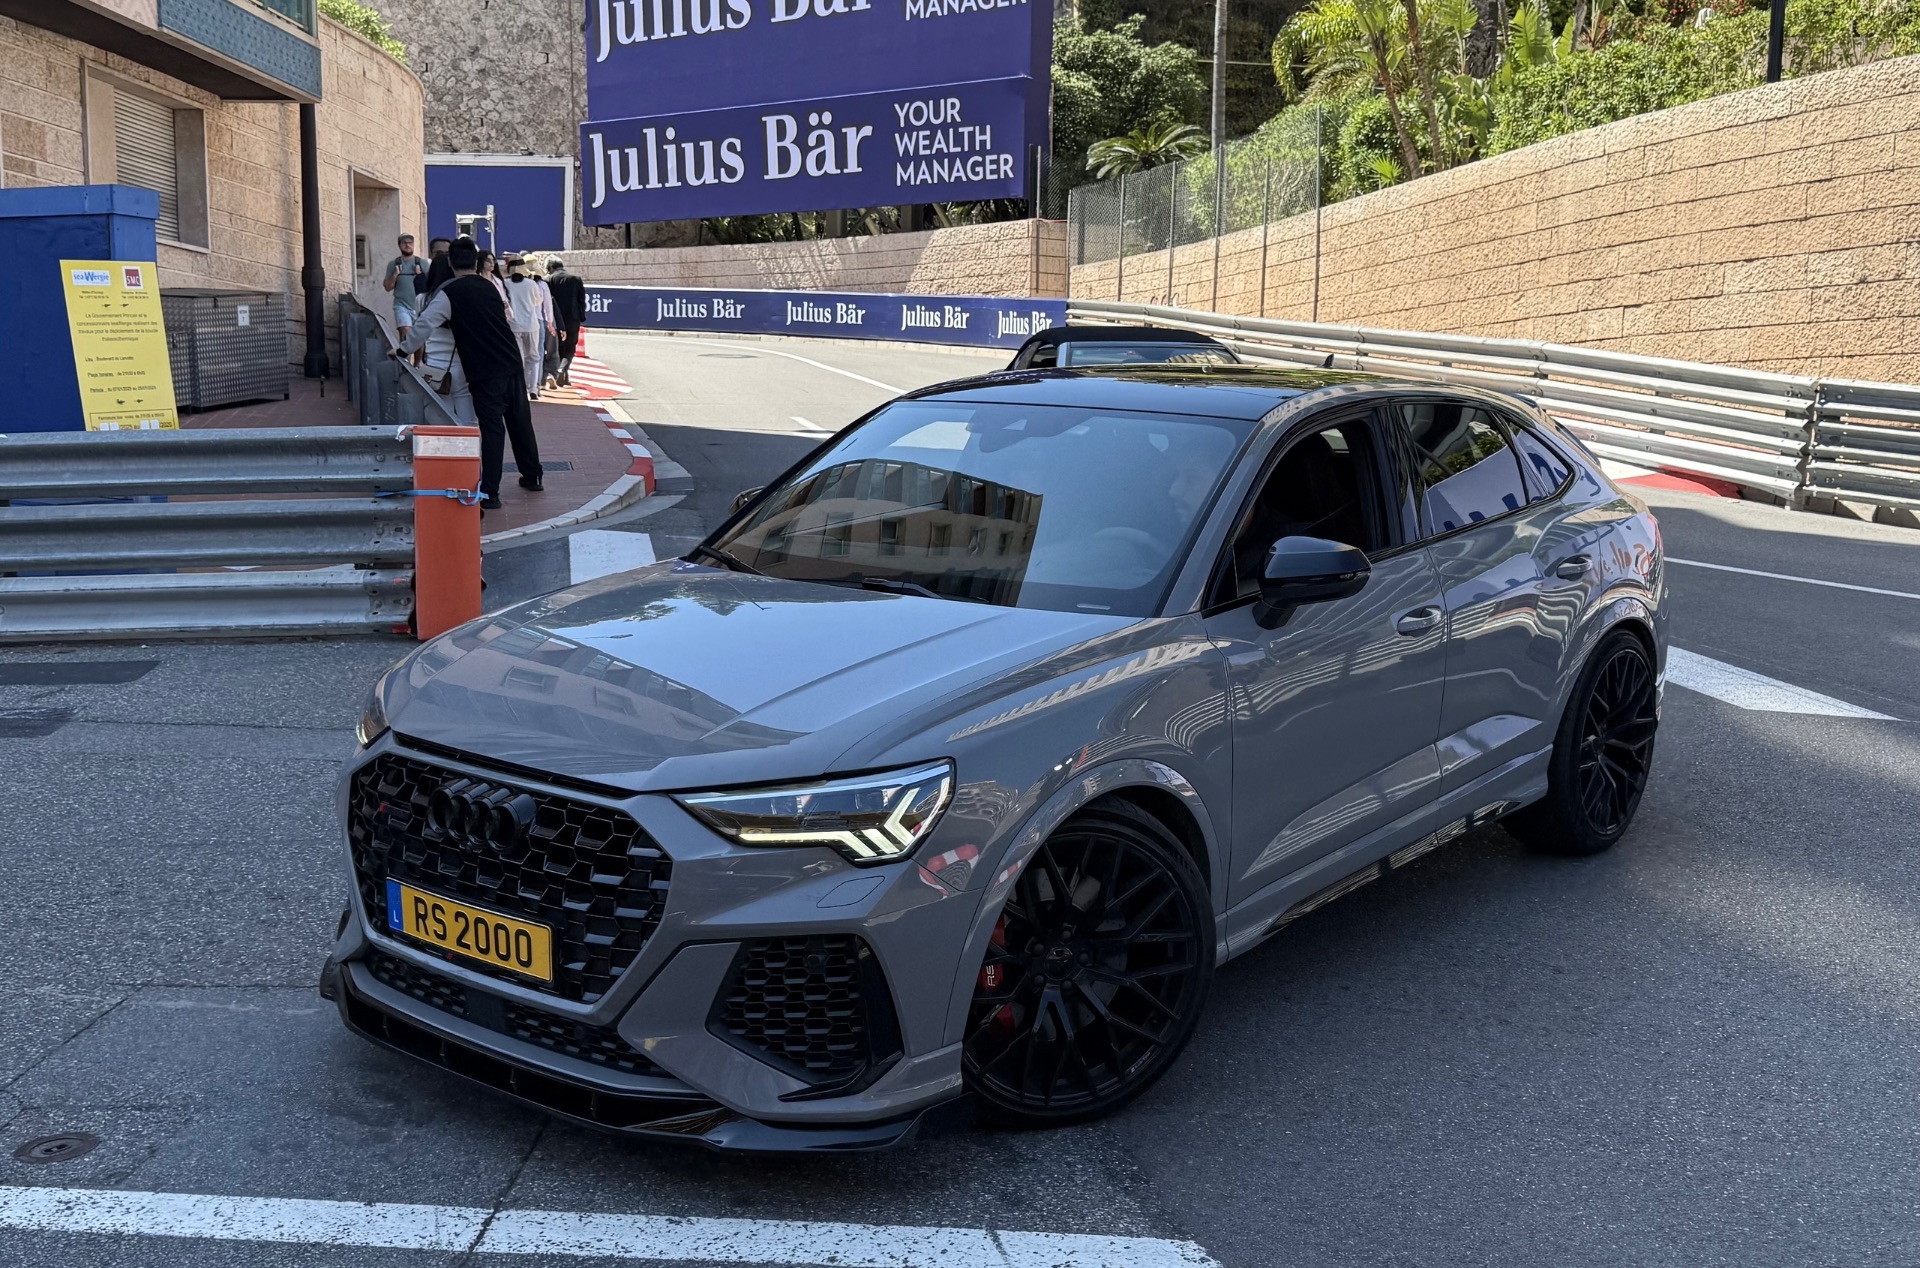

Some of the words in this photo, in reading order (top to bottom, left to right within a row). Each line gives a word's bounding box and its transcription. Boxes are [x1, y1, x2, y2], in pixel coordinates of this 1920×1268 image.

[905, 0, 1027, 20] MANA
[596, 0, 751, 62] Julius
[894, 98, 961, 128] YOUR
[895, 125, 991, 158] WEALTH
[588, 126, 745, 208] Julius
[762, 111, 873, 181] Bär
[895, 154, 1014, 186] MANAGER
[126, 275, 141, 286] SMC
[656, 298, 708, 322] Julius
[712, 298, 745, 319] Bär
[786, 300, 832, 326] Julius
[836, 302, 866, 325] Bär
[901, 304, 941, 331] Julius
[944, 305, 970, 329] Bär
[997, 310, 1030, 339] Julius
[1031, 311, 1053, 335] Bär
[393, 909, 399, 923] L
[413, 895, 447, 941] RS
[454, 910, 533, 968] 2000
[986, 965, 995, 986] RS
